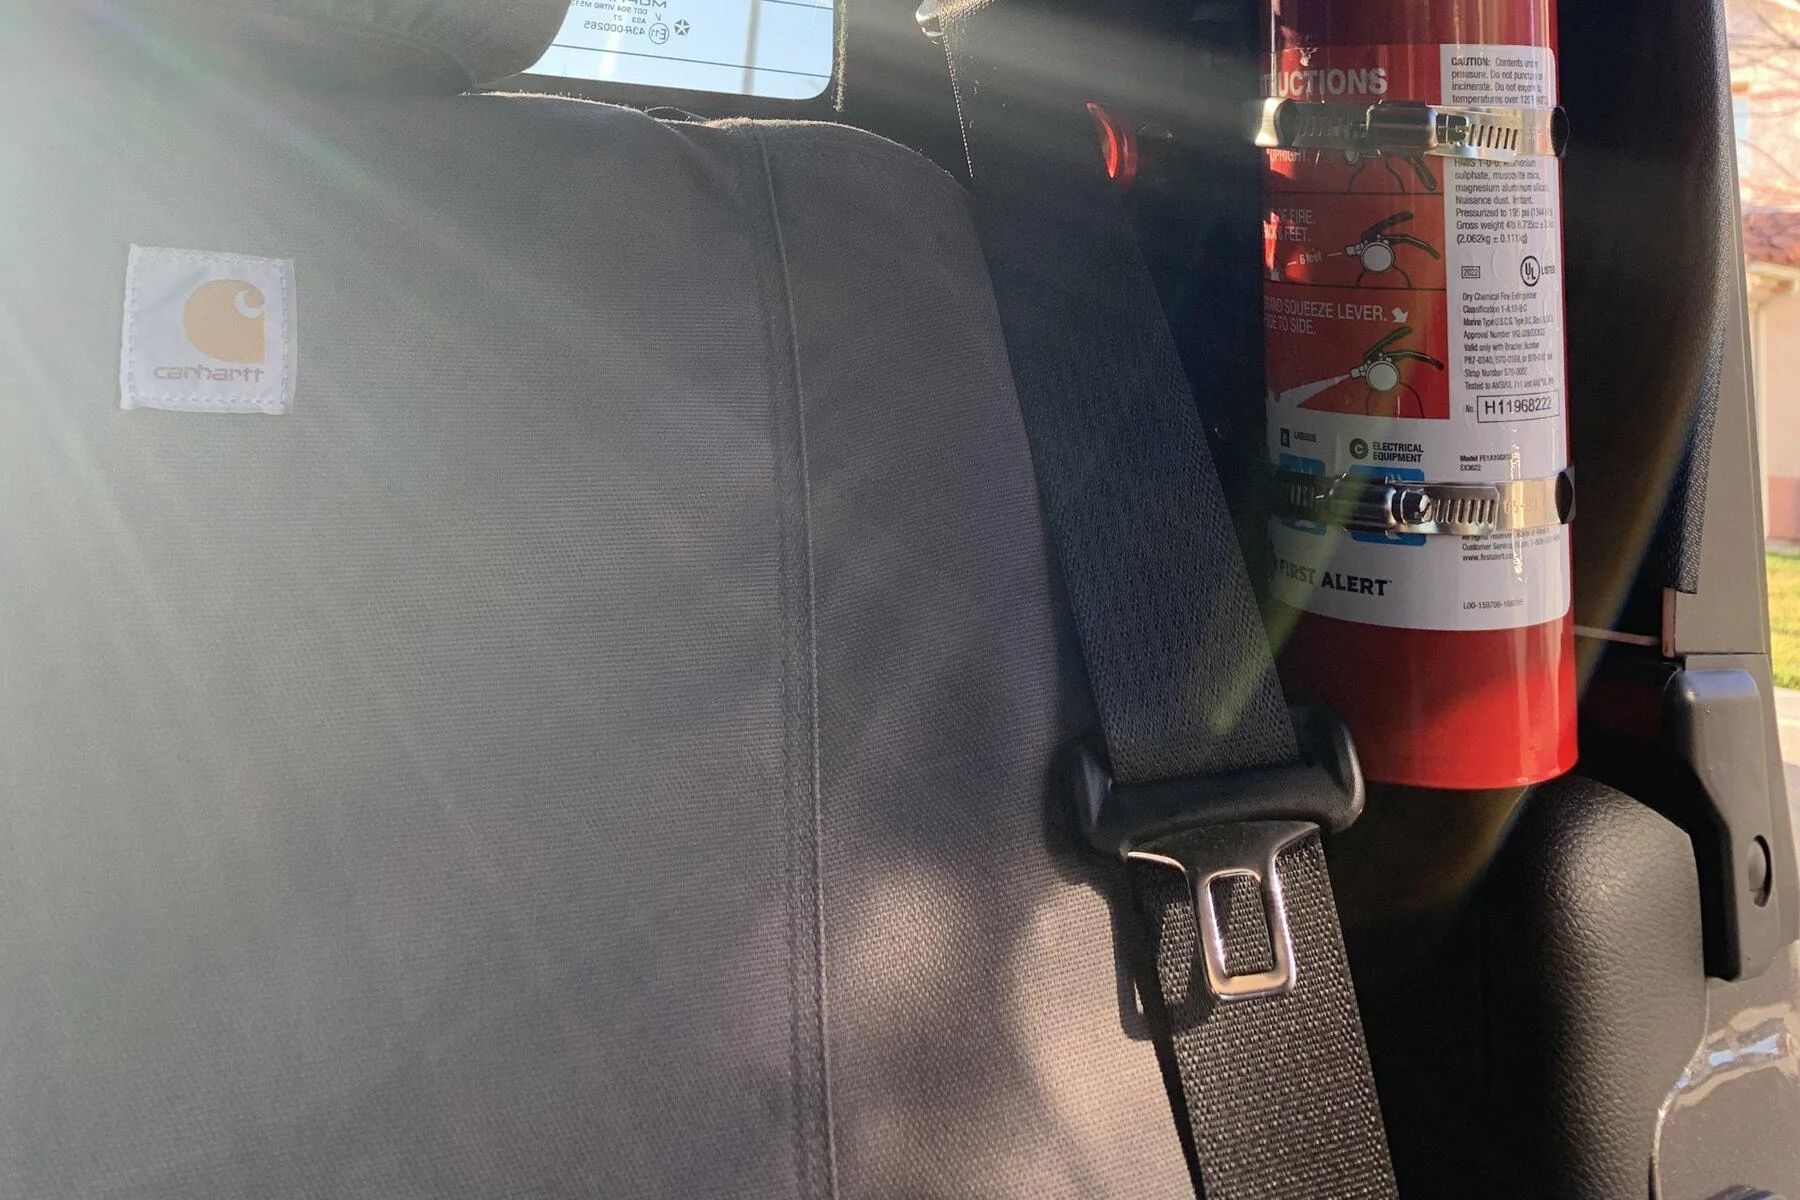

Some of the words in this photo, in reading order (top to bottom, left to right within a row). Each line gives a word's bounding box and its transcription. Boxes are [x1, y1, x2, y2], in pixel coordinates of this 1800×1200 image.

[1451, 56, 1490, 66] CAUTION:
[1495, 57, 1523, 68] Contents
[1452, 70, 1488, 80] pressure.
[1490, 70, 1500, 79] Do
[1501, 71, 1513, 79] not
[1452, 82, 1493, 91] incinerate.
[1495, 82, 1505, 91] Do
[1506, 83, 1517, 91] not
[1452, 94, 1504, 105] temperatures
[1504, 96, 1519, 104] over
[1454, 171, 1491, 181] sulphate,
[1455, 184, 1500, 193] magnesium
[1455, 195, 1492, 205] Nuisance
[1455, 208, 1499, 217] Pressurized
[1500, 208, 1507, 217] to
[1456, 220, 1479, 230] Gross
[1480, 220, 1505, 231] weight
[1456, 234, 1491, 245] (2.062kg
[1463, 292, 1473, 302] Dry
[1474, 292, 1500, 300] Chemical
[1501, 292, 1510, 300] Fire
[1284, 299, 1333, 319] SQUEEZE
[1337, 304, 1388, 322] LEVER.
[1463, 304, 1500, 313] Classification
[1290, 317, 1317, 335] SIDE.
[1463, 318, 1482, 326] Marine
[1482, 317, 1495, 327] Type
[1463, 330, 1489, 340] Approval
[1489, 330, 1511, 339] Number
[1464, 343, 1478, 352] Valid
[1479, 343, 1491, 352] only
[1492, 343, 1503, 351] with
[153, 364, 265, 383] carhartt
[1464, 369, 1480, 378] Strap
[1481, 368, 1504, 377] Number
[1465, 381, 1484, 390] Tested
[1485, 382, 1491, 390] to
[1485, 396, 1552, 415] H11968222
[1373, 441, 1424, 453] ELECTRICAL
[1373, 452, 1423, 463] EQUIPMENT
[1460, 454, 1478, 462] Model
[1462, 543, 1491, 552] Customer
[1279, 558, 1317, 585] FIRST
